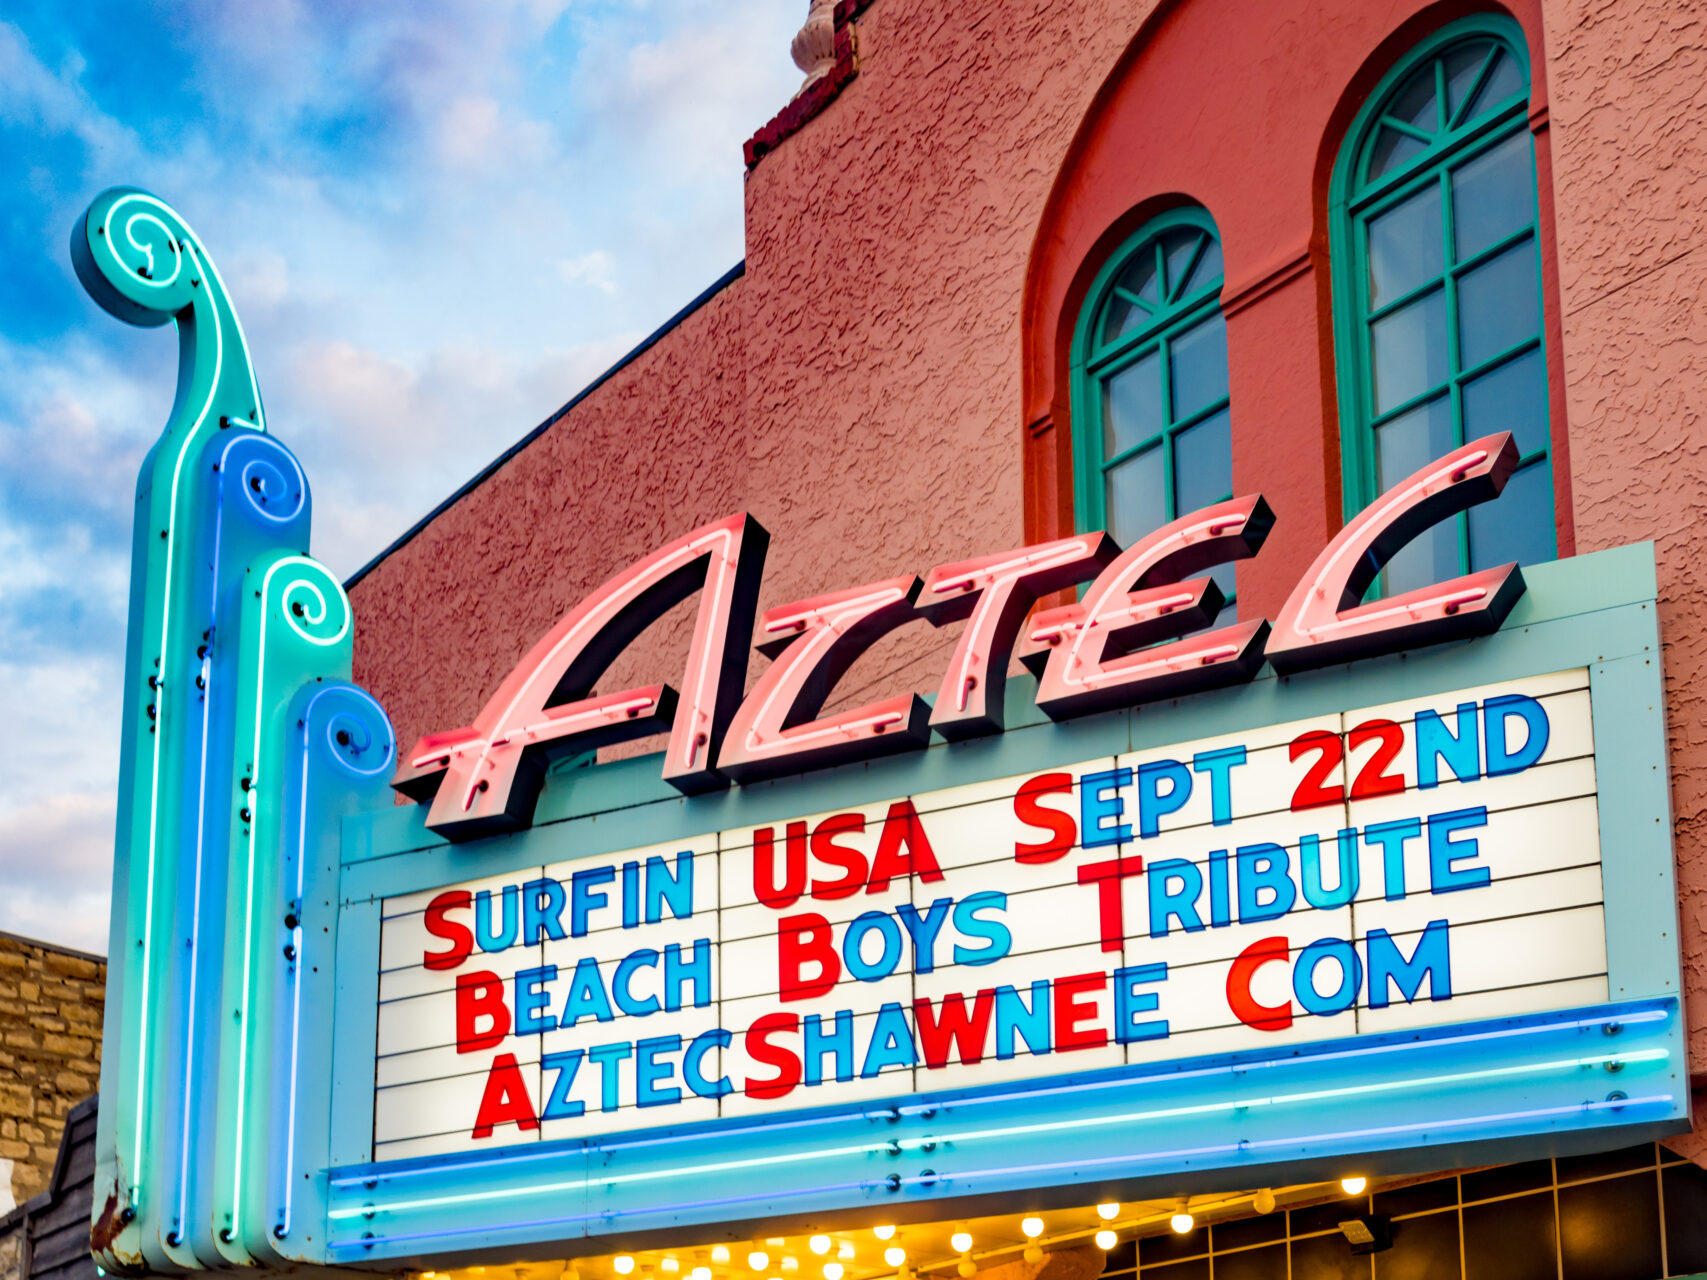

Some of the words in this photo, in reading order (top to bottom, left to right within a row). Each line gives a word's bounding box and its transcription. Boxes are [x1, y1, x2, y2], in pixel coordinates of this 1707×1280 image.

[424, 851, 694, 971] SURFIN
[753, 800, 945, 909] USA
[1013, 745, 1247, 865] SEPT
[1289, 694, 1550, 813] 22ND
[456, 938, 712, 1055] BEACH
[778, 890, 1012, 1003] BOYS
[1077, 806, 1491, 953] TRIBUTE
[1226, 919, 1452, 1032] COM
